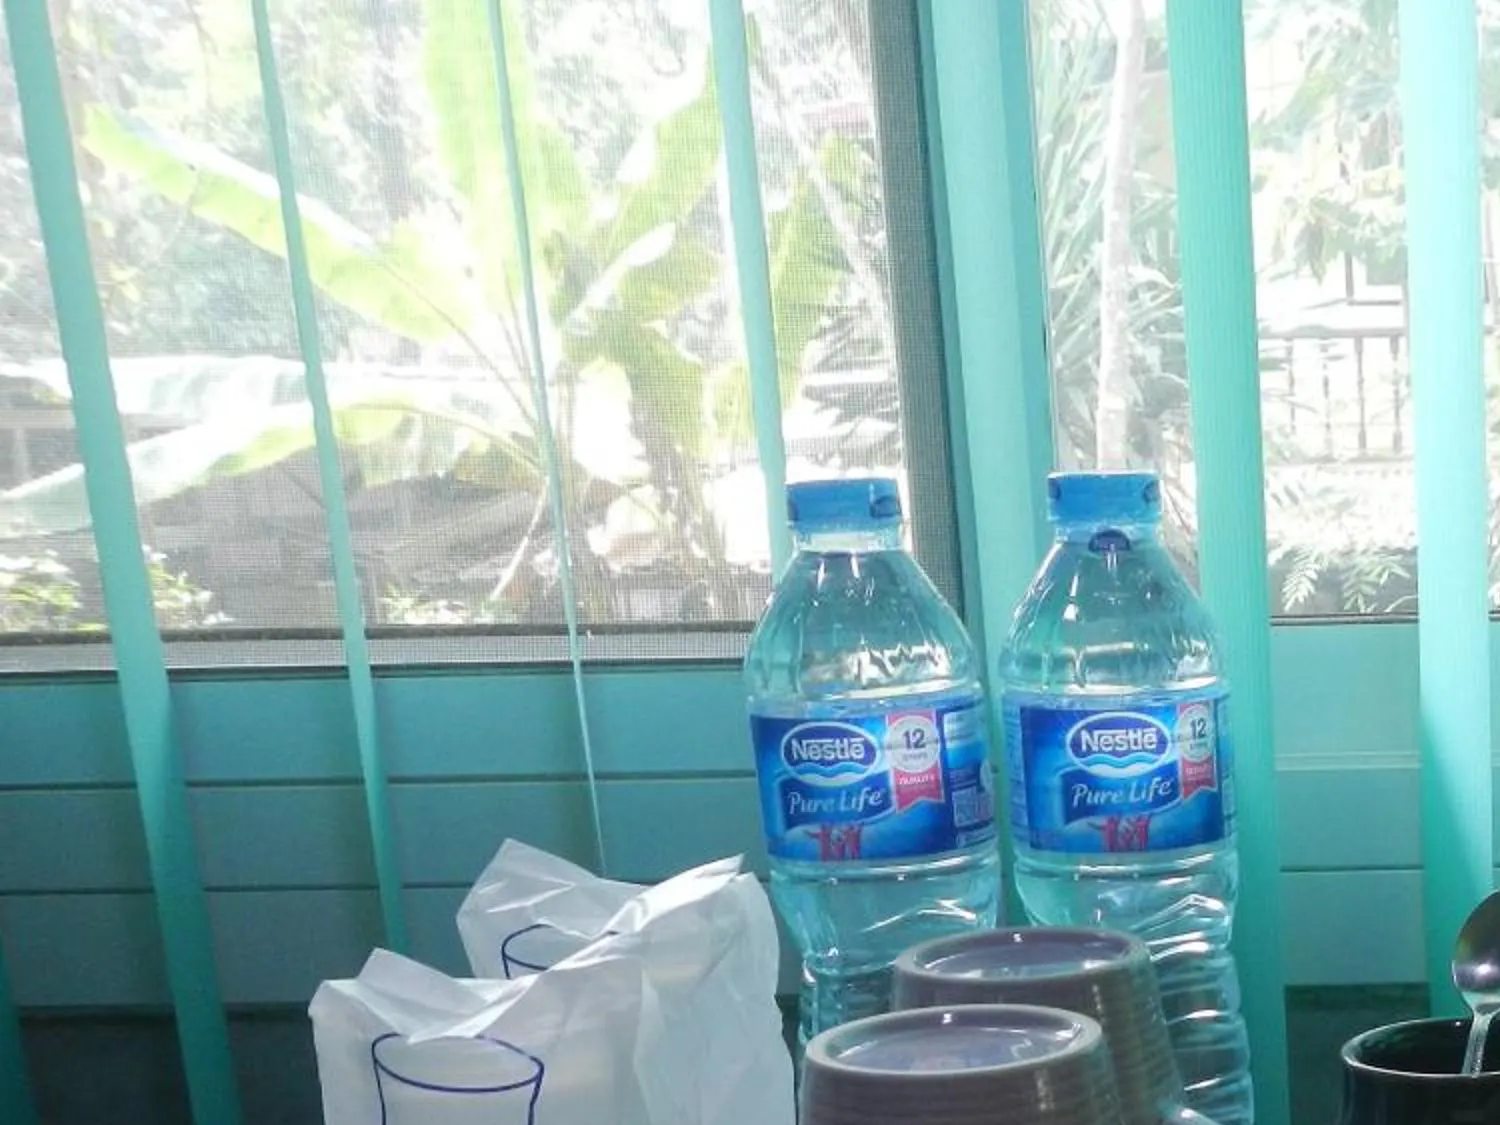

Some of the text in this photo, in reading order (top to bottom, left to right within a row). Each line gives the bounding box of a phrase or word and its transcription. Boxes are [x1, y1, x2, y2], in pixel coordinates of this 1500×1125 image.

[902, 728, 927, 751] 12
[1190, 717, 1208, 739] 12
[787, 786, 884, 816] Pure Life
[1071, 776, 1176, 809] Pure Life
